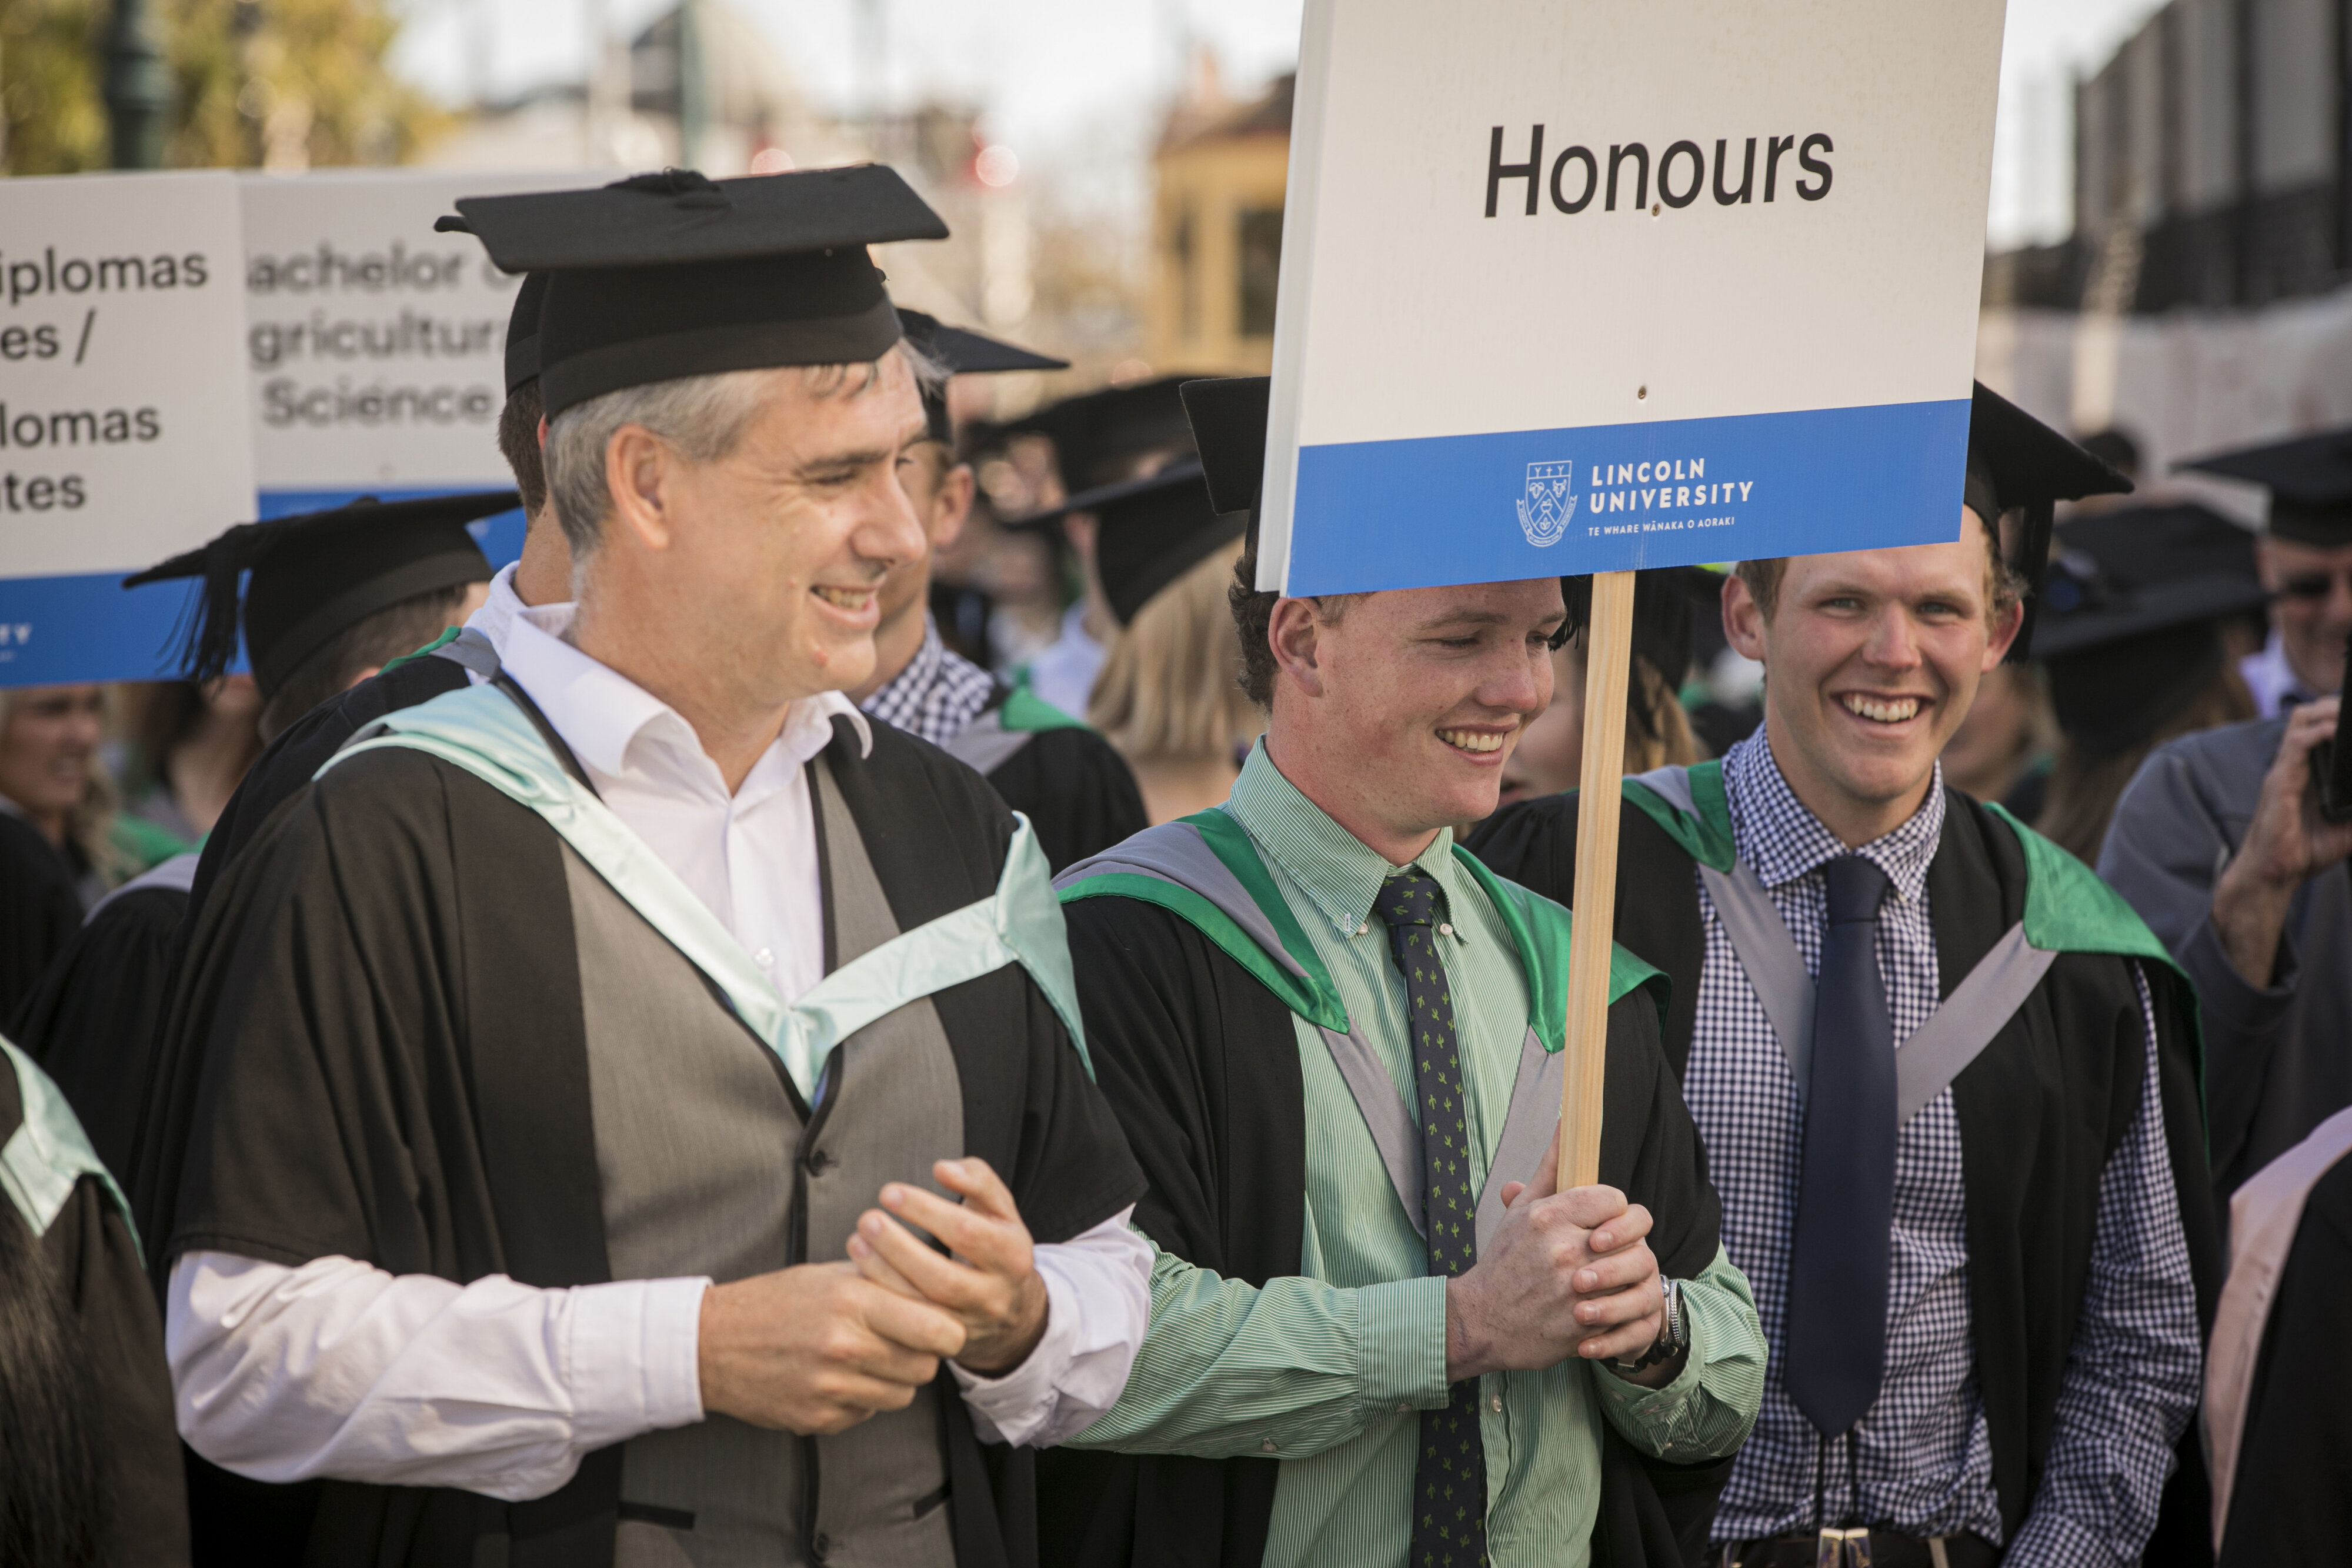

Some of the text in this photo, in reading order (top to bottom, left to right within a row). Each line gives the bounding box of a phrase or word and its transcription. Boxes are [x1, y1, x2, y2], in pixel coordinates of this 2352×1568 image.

[1484, 124, 1834, 218] Honours
[249, 308, 507, 371] gricultur
[262, 377, 494, 429] Science
[1592, 458, 1704, 486] LINCOLN
[1590, 481, 1754, 513] UNIVERSITY
[1589, 516, 1735, 536] TE WHARE WĀNAKA O AORAKI
